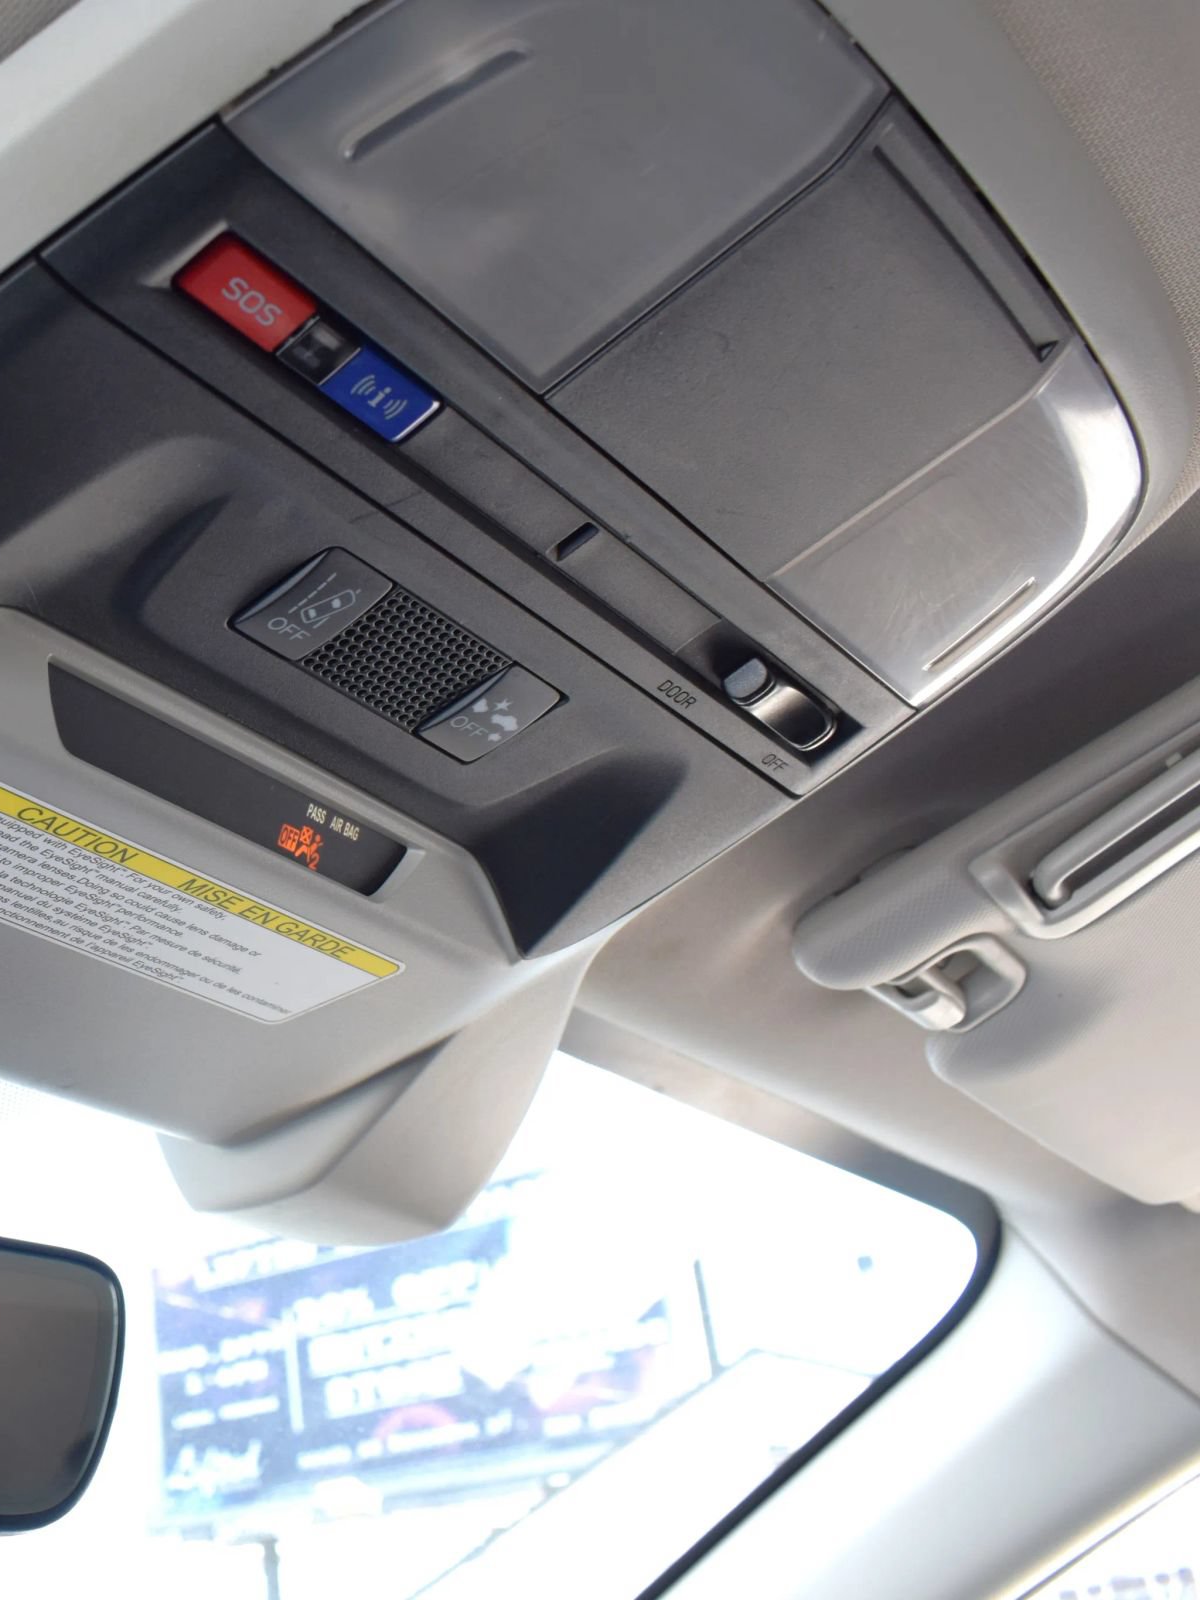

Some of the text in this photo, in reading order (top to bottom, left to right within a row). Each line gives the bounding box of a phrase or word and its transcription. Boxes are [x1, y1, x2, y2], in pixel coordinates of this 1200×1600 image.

[222, 277, 283, 326] SOS
[267, 617, 310, 640] OFF
[657, 679, 697, 709] DOOR
[451, 715, 488, 736] OFF
[761, 753, 789, 771] OFF
[17, 807, 139, 863] CAUTION
[280, 827, 299, 850] OFF
[306, 803, 359, 840] PASS AIR BAG
[11, 862, 66, 887] improper
[18, 839, 40, 852] the
[95, 873, 140, 894] manual
[42, 837, 68, 851] with
[125, 872, 148, 884] For
[147, 882, 173, 895] your
[170, 893, 195, 906] own
[9, 876, 75, 906] technologie
[128, 925, 151, 936] Par
[148, 934, 189, 952] mesure
[187, 950, 203, 958] de
[35, 900, 53, 909] du
[108, 892, 126, 901] so
[123, 898, 158, 913] could
[154, 911, 187, 927] cause
[185, 923, 210, 936] lens
[208, 934, 249, 953] damage
[177, 879, 356, 957] MISE EN GARDE
[68, 936, 85, 945] de
[68, 925, 103, 941] risque
[101, 938, 119, 947] de
[117, 943, 136, 953] les
[135, 951, 200, 976] endommager
[198, 976, 214, 984] ou
[212, 982, 228, 990] de
[225, 986, 243, 996] les
